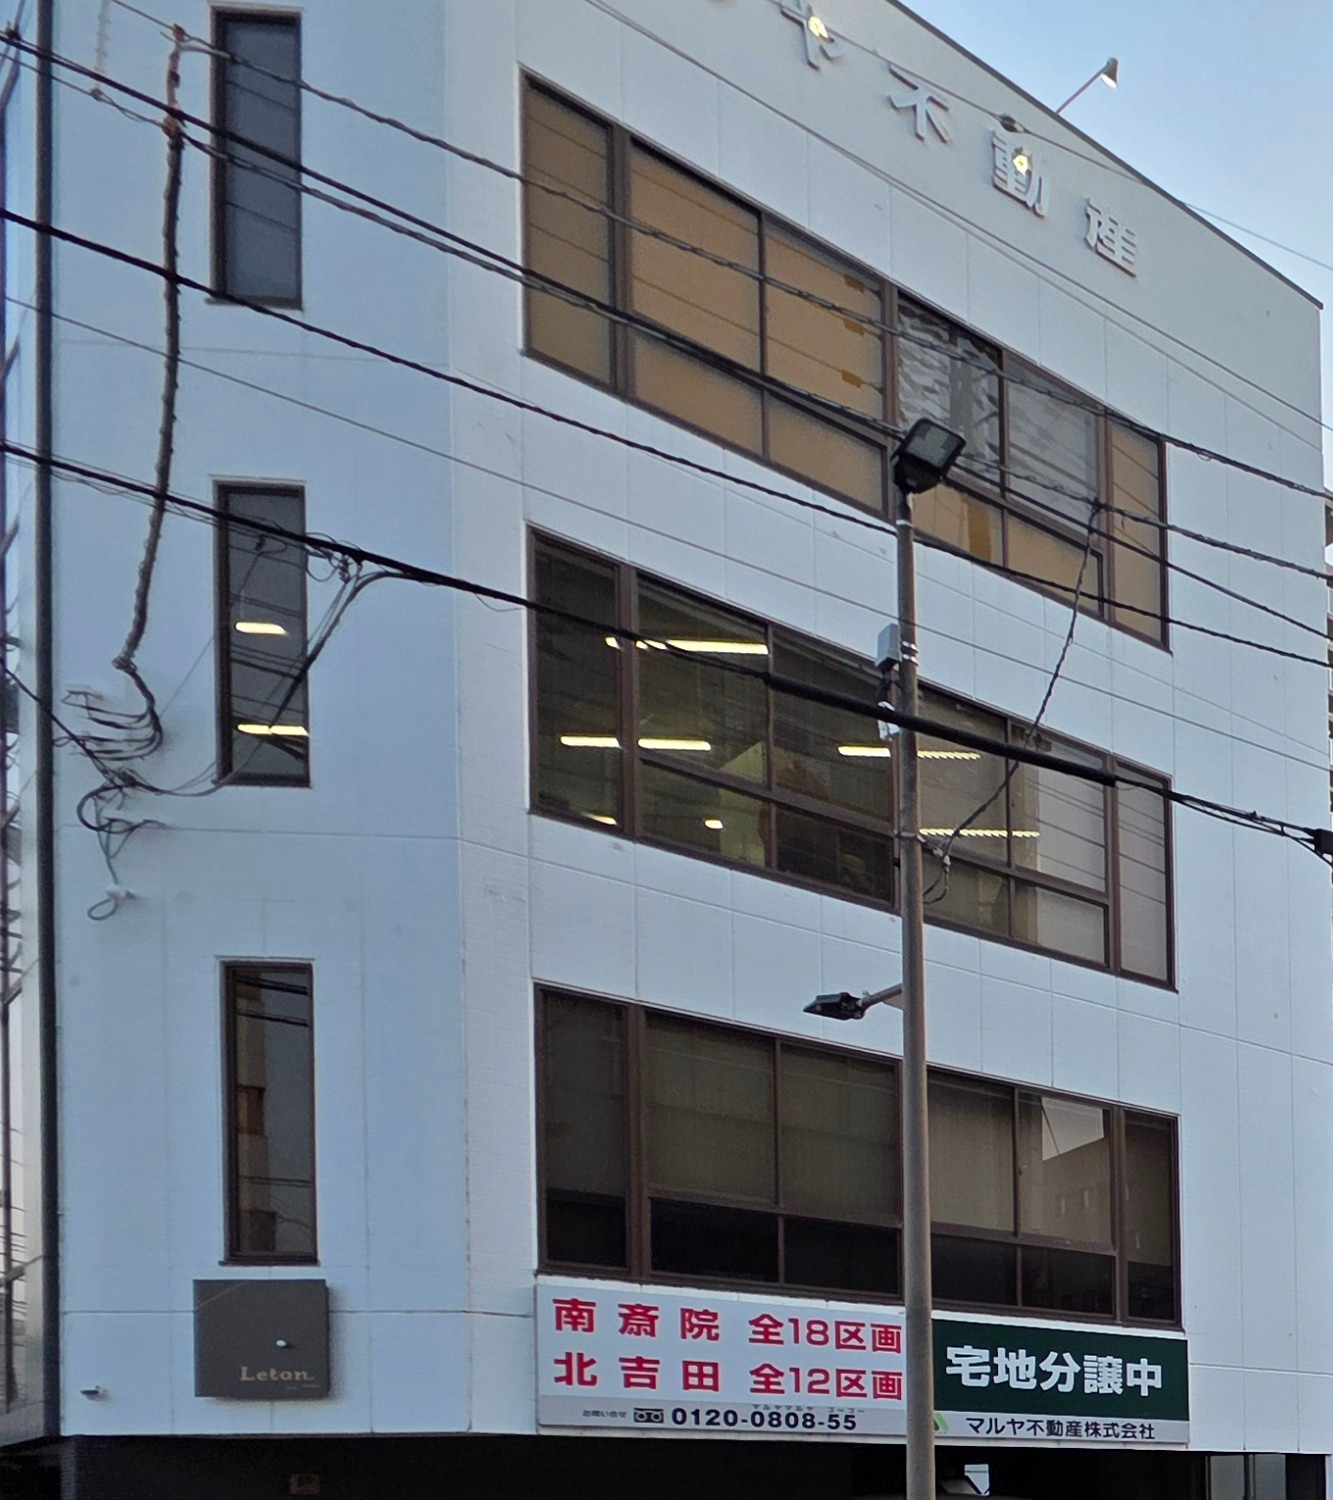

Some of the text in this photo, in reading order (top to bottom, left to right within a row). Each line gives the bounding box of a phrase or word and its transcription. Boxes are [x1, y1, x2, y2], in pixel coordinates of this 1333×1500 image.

[748, 1313, 902, 1354] 全18区画
[553, 1351, 903, 1401] 北吉田 全12区画
[945, 1345, 1162, 1397] 宅地分譲中
[671, 1407, 857, 1431] 0120-0808-55
[965, 1416, 1156, 1440] マルヤ不動産株式会社
